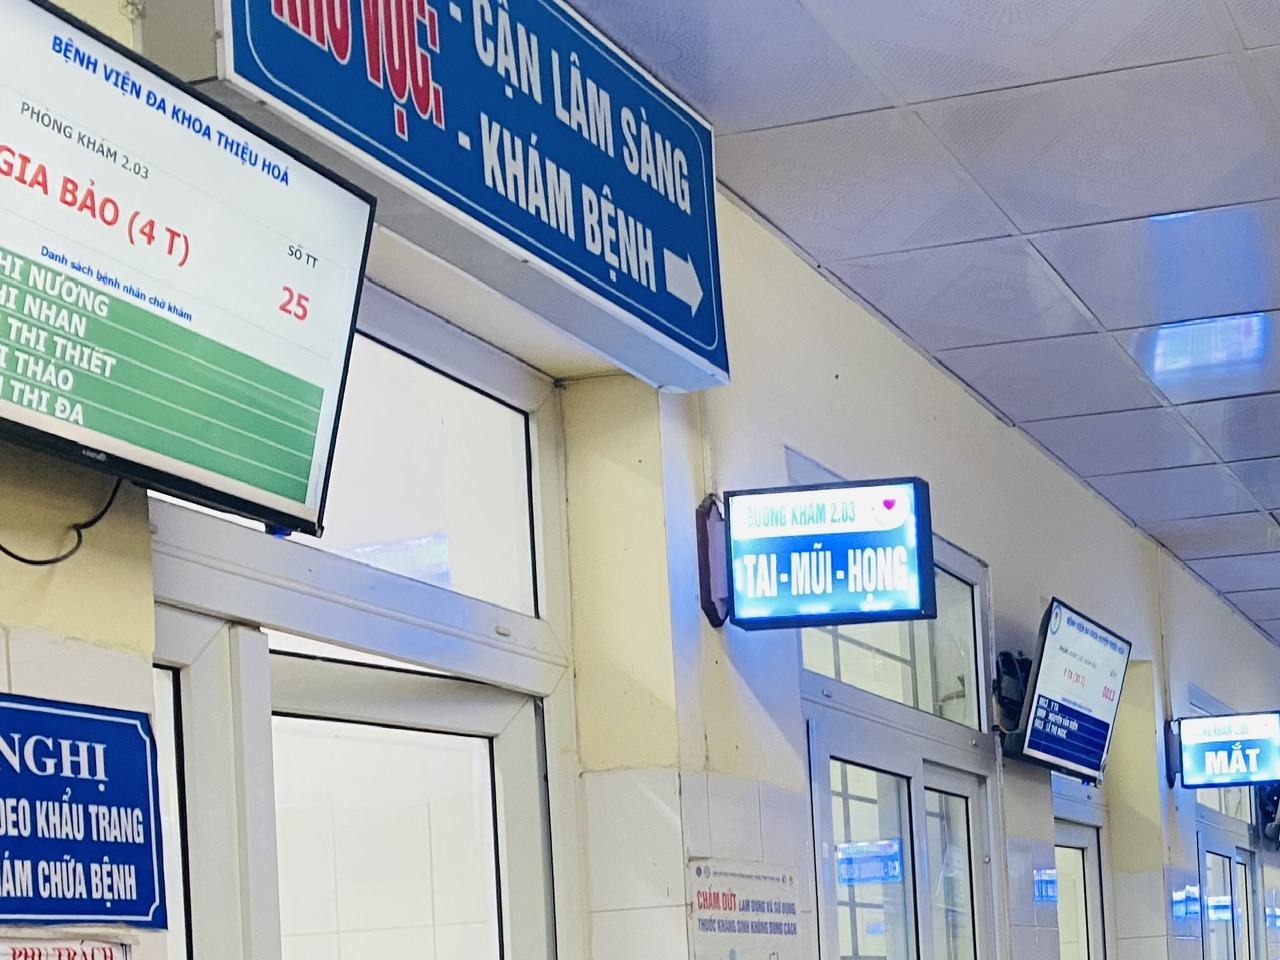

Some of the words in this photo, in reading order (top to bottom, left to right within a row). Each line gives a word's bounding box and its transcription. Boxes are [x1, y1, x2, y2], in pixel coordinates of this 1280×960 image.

[51, 35, 98, 75] BỆNH
[102, 63, 142, 100] VIỆN
[146, 89, 167, 115] ĐA
[171, 106, 212, 141] KHOA
[216, 130, 258, 167] THIỆU
[20, 101, 73, 140] PHÒNG
[76, 130, 118, 165] KHÁM
[121, 154, 150, 180] 2.03
[551, 52, 615, 158] LÂM
[620, 106, 692, 215] SÀNG
[0, 144, 50, 196] GIA
[59, 176, 120, 227] BẢO
[126, 210, 156, 248] (4
[164, 226, 191, 268] T)
[480, 112, 576, 242] KHÁM
[580, 183, 657, 293] BỆNH
[41, 245, 68, 266] Danh
[70, 259, 94, 278] sách
[96, 269, 121, 290] bệnh
[122, 282, 147, 301] nhân
[148, 292, 166, 309] chờ
[167, 299, 193, 323] khám
[305, 253, 319, 269] TT
[23, 293, 87, 338] NHAN
[28, 264, 110, 317] NƯƠNG
[278, 285, 310, 321] 25
[830, 501, 856, 524] 2.03
[744, 553, 777, 599] TAI
[791, 542, 833, 596] MŨI
[847, 545, 909, 603] HỌNG
[0, 733, 108, 792] NGHỊ
[1205, 742, 1260, 775] MẮT
[36, 787, 85, 841] KHẨU
[88, 804, 145, 844] TRANG
[0, 850, 33, 898] ÁM
[38, 854, 87, 899] CHỮA
[91, 856, 137, 908] BỆNH
